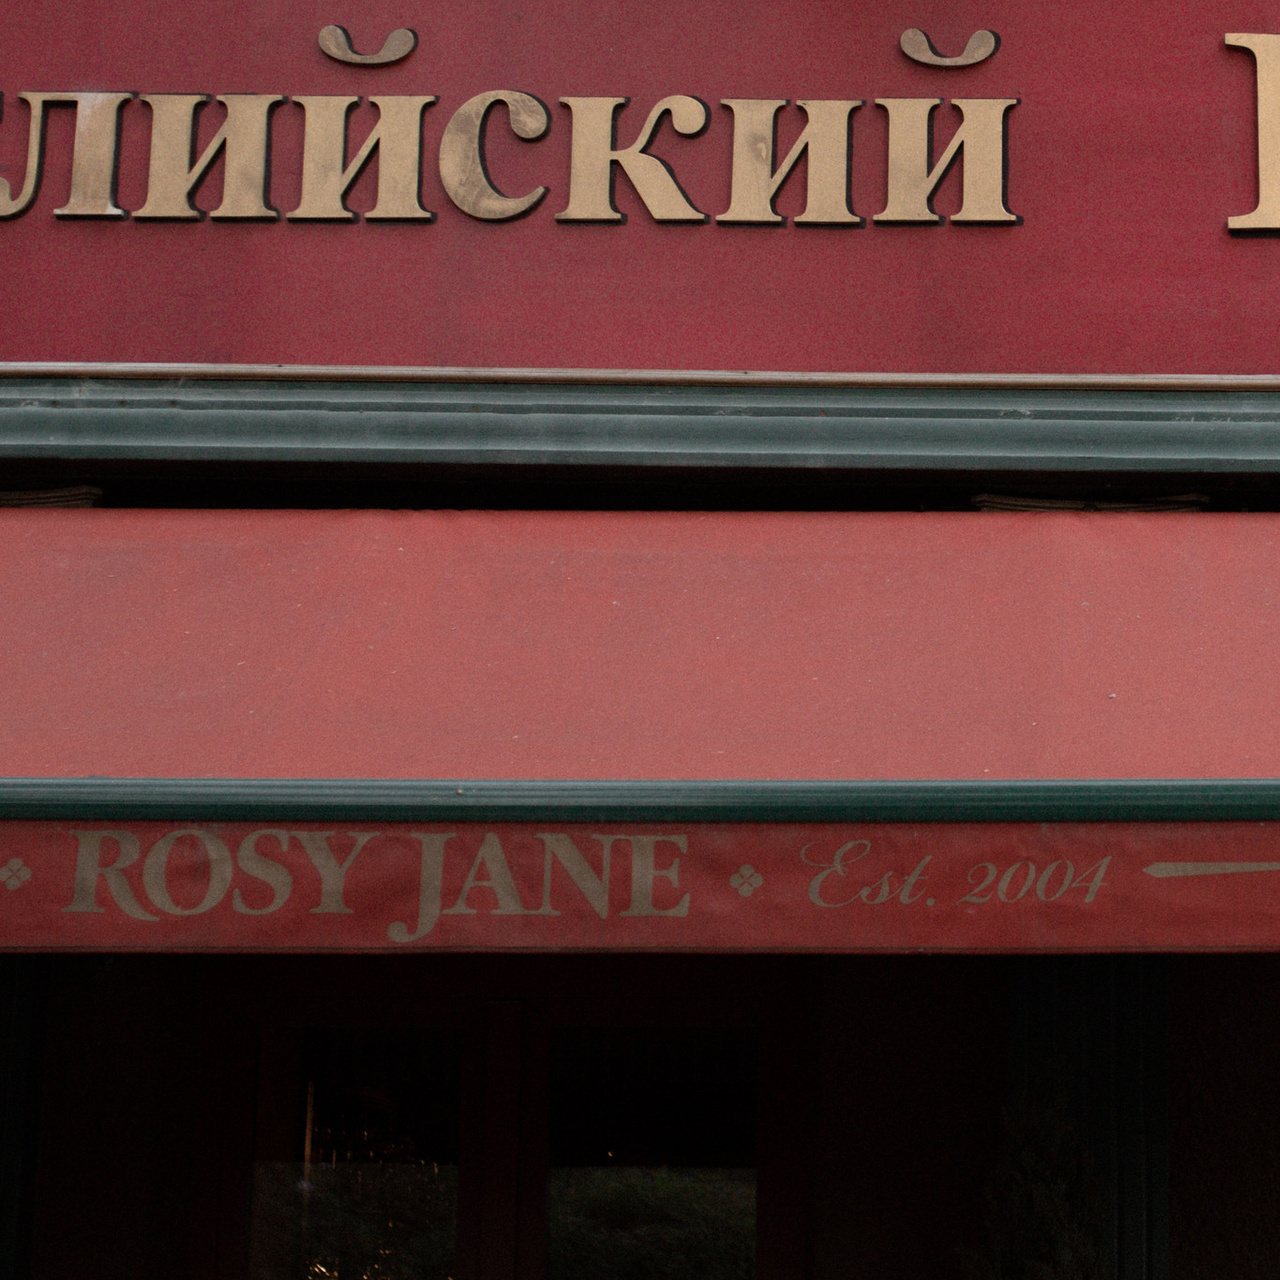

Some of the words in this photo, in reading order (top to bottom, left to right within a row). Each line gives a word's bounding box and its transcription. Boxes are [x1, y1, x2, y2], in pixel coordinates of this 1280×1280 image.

[61, 828, 380, 921] ROSY
[387, 831, 691, 943] JANE
[800, 839, 935, 908] Est.
[957, 855, 1113, 905] 2004
